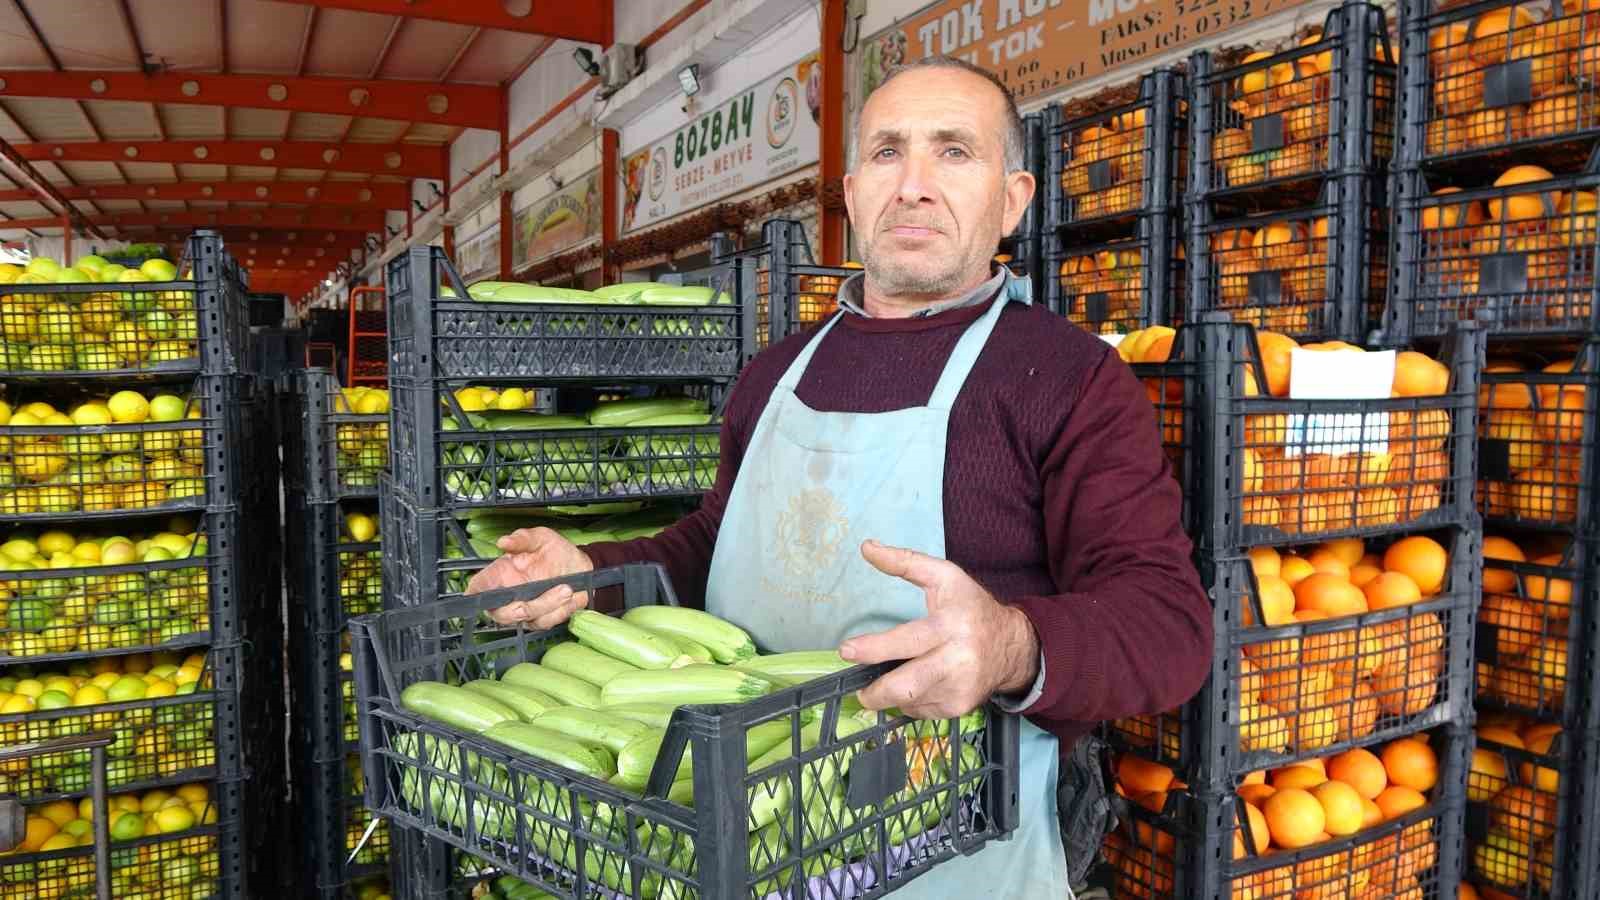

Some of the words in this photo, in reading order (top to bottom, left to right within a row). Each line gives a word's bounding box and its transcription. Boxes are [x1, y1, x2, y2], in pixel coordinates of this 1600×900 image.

[919, 0, 983, 58] TOK
[988, 22, 1044, 65] TOK
[1101, 42, 1147, 67] Musa
[674, 92, 754, 168] BOZBAY
